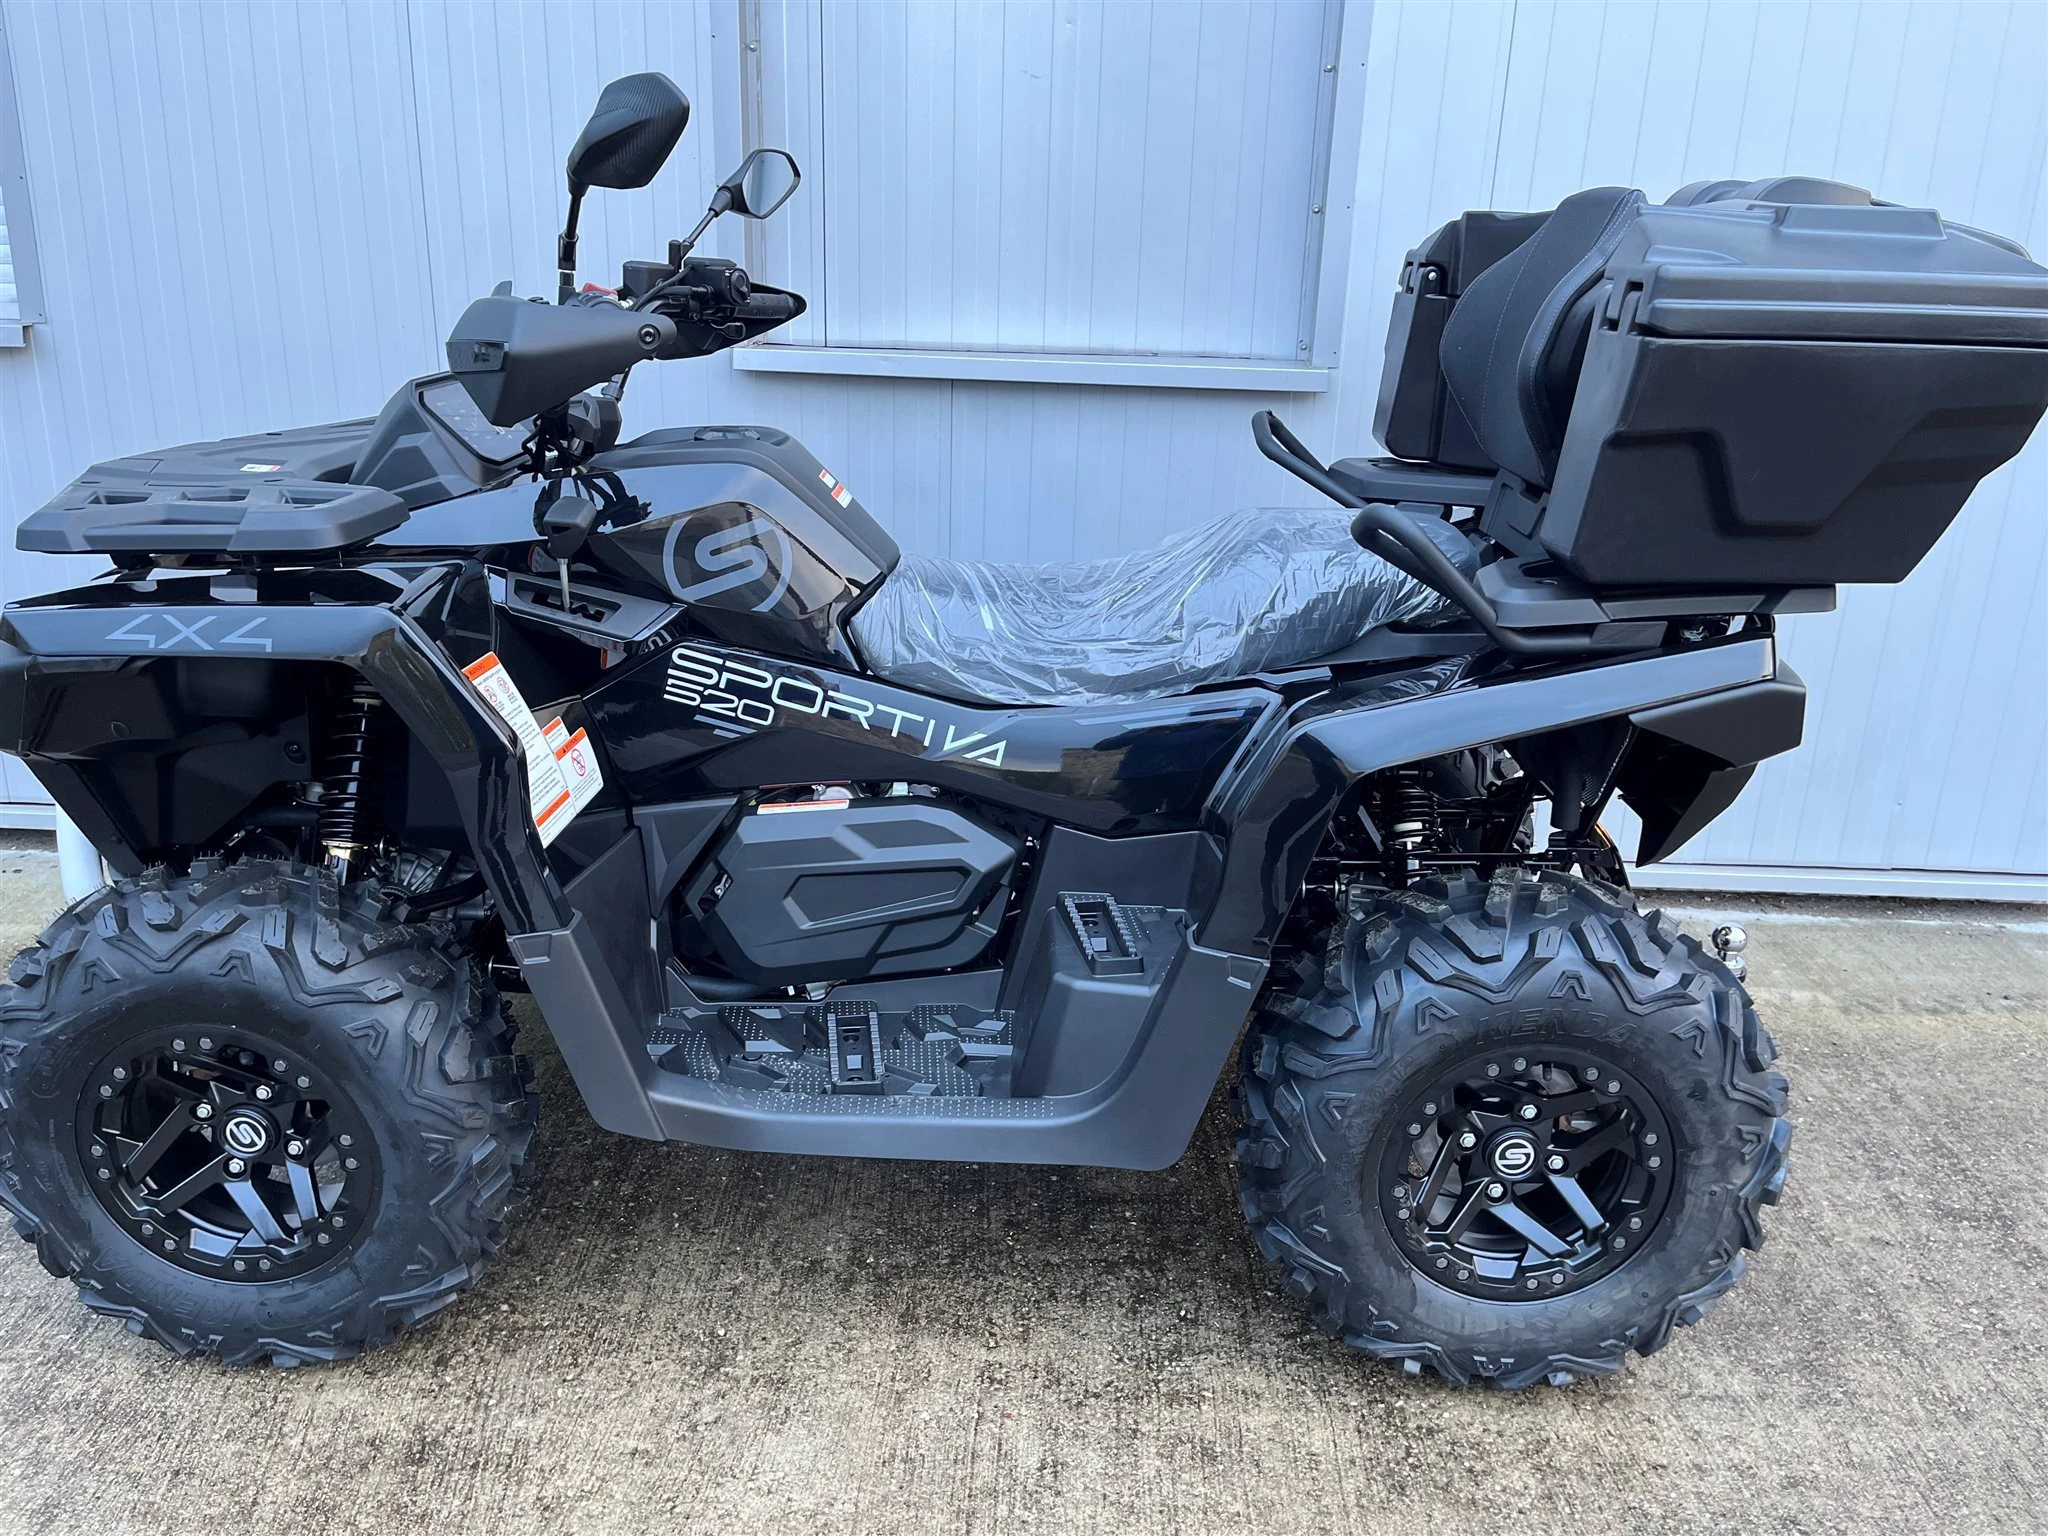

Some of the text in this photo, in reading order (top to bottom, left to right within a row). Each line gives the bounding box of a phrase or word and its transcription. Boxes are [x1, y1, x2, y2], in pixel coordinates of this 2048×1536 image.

[663, 679, 774, 726] 520
[667, 648, 1006, 766] SPORTIVA
[1476, 1007, 1637, 1047] KENDA
